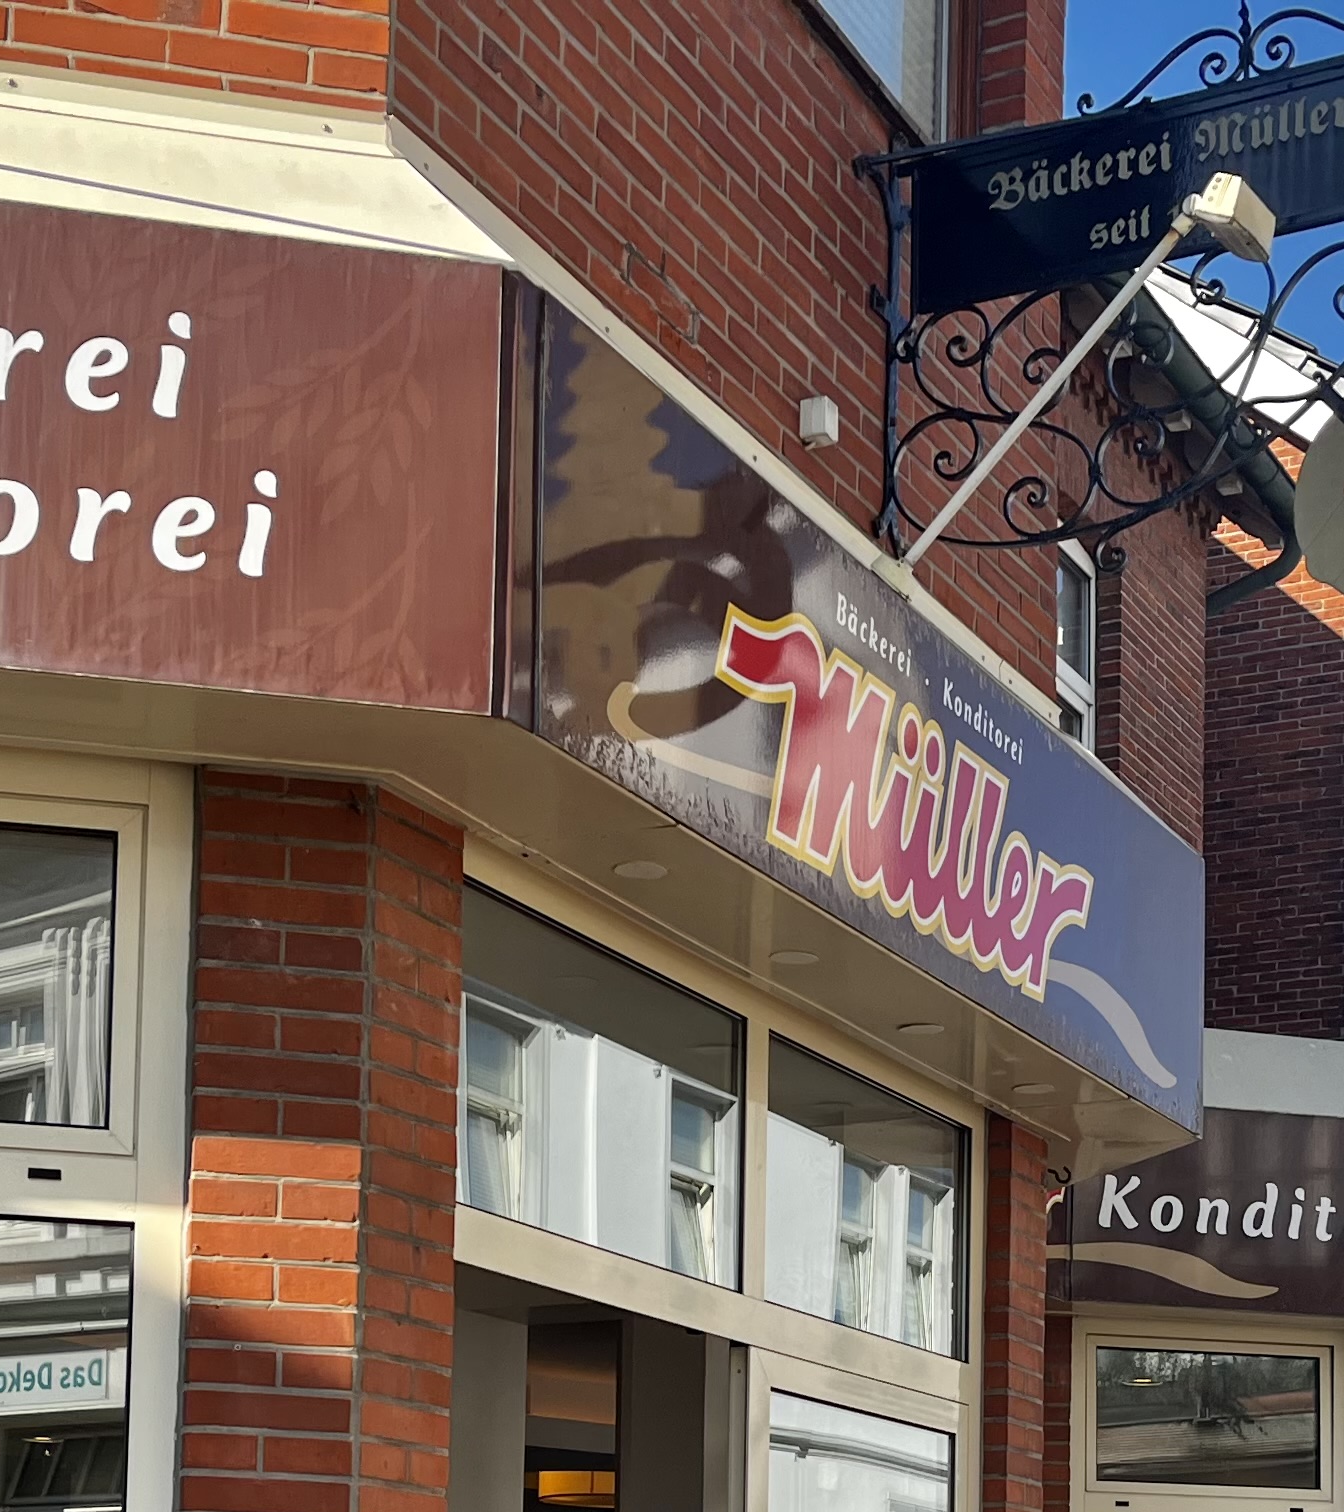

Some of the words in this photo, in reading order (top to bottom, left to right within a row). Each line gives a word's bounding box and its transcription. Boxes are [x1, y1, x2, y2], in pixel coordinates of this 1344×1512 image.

[987, 130, 1172, 212] Bäckerei
[1088, 211, 1150, 253] seit
[834, 591, 913, 678] Bäckerei
[943, 679, 1026, 766] Konditorei
[716, 603, 1094, 1002] Müller
